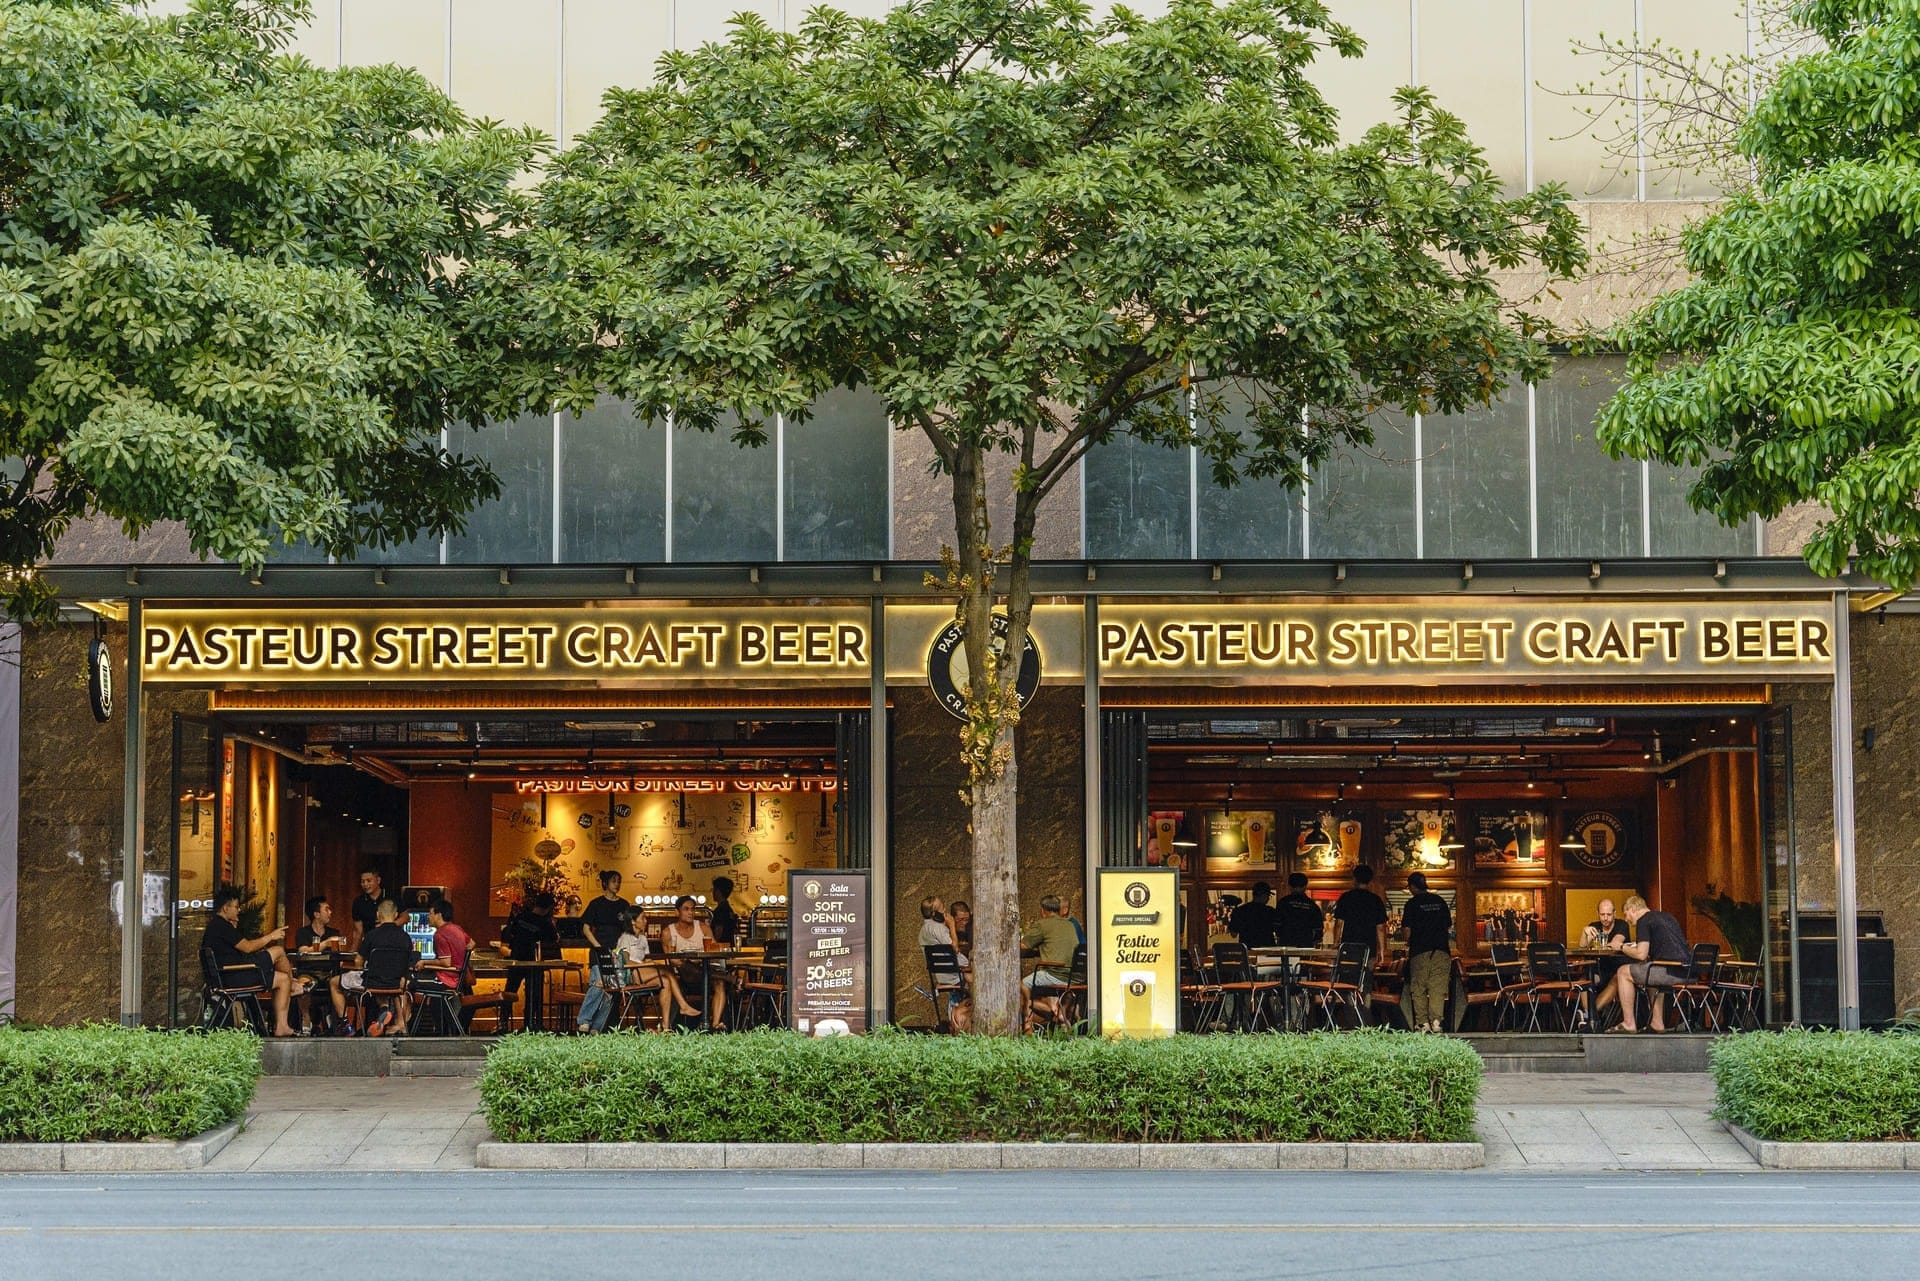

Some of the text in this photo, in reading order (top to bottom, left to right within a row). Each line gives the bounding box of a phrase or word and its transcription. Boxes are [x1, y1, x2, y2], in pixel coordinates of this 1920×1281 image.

[145, 625, 866, 665] PASTEUR STREET CRAFT BEER
[1101, 620, 1831, 661] PASTEUR STREET CRAFT BEER
[815, 901, 843, 912] SOFT
[802, 913, 856, 923] OPENING
[1116, 934, 1160, 948] Festive
[809, 947, 850, 958] FIRST BEER
[1116, 949, 1161, 963] Seltzer
[826, 958, 833, 967] &
[806, 977, 853, 990] ON BEERS
